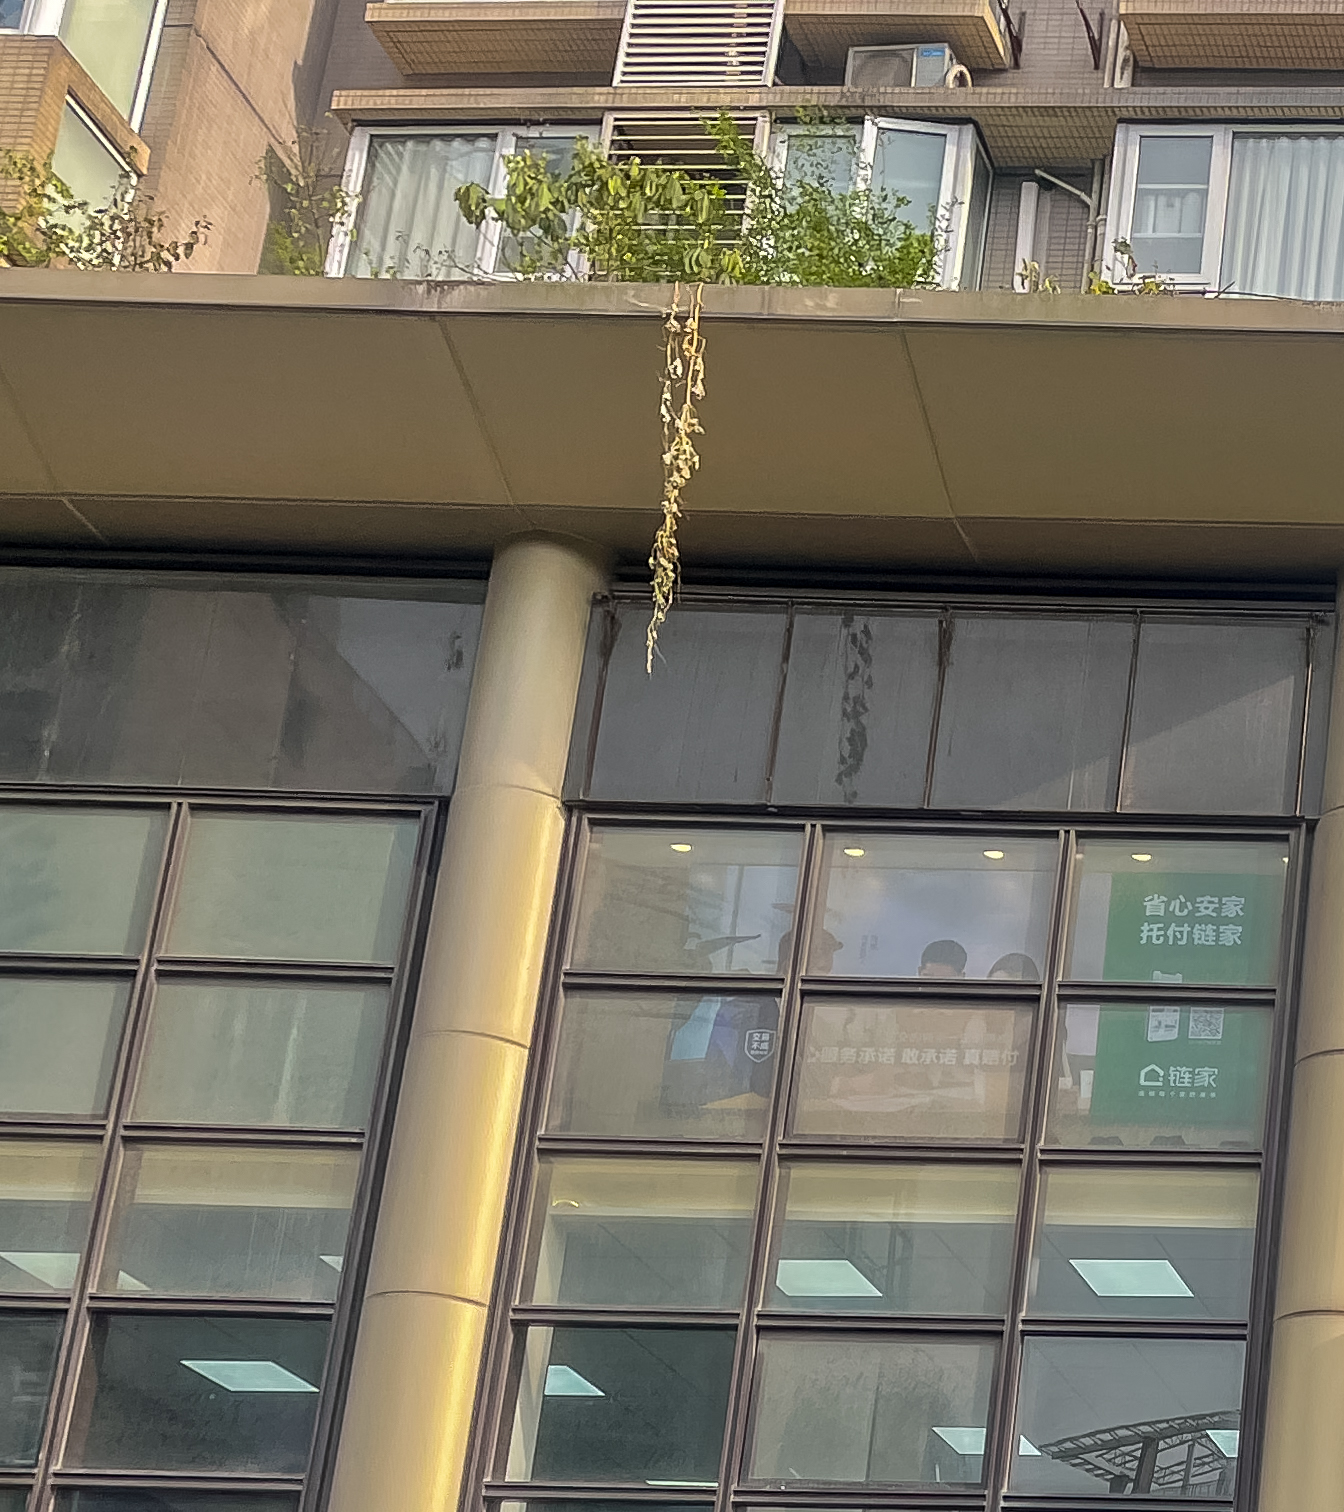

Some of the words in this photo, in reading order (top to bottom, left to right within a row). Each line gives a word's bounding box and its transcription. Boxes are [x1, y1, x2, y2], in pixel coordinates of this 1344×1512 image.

[1143, 894, 1245, 918] 省心安家
[1140, 922, 1242, 946] 托付链家
[1168, 1066, 1218, 1087] 链家
